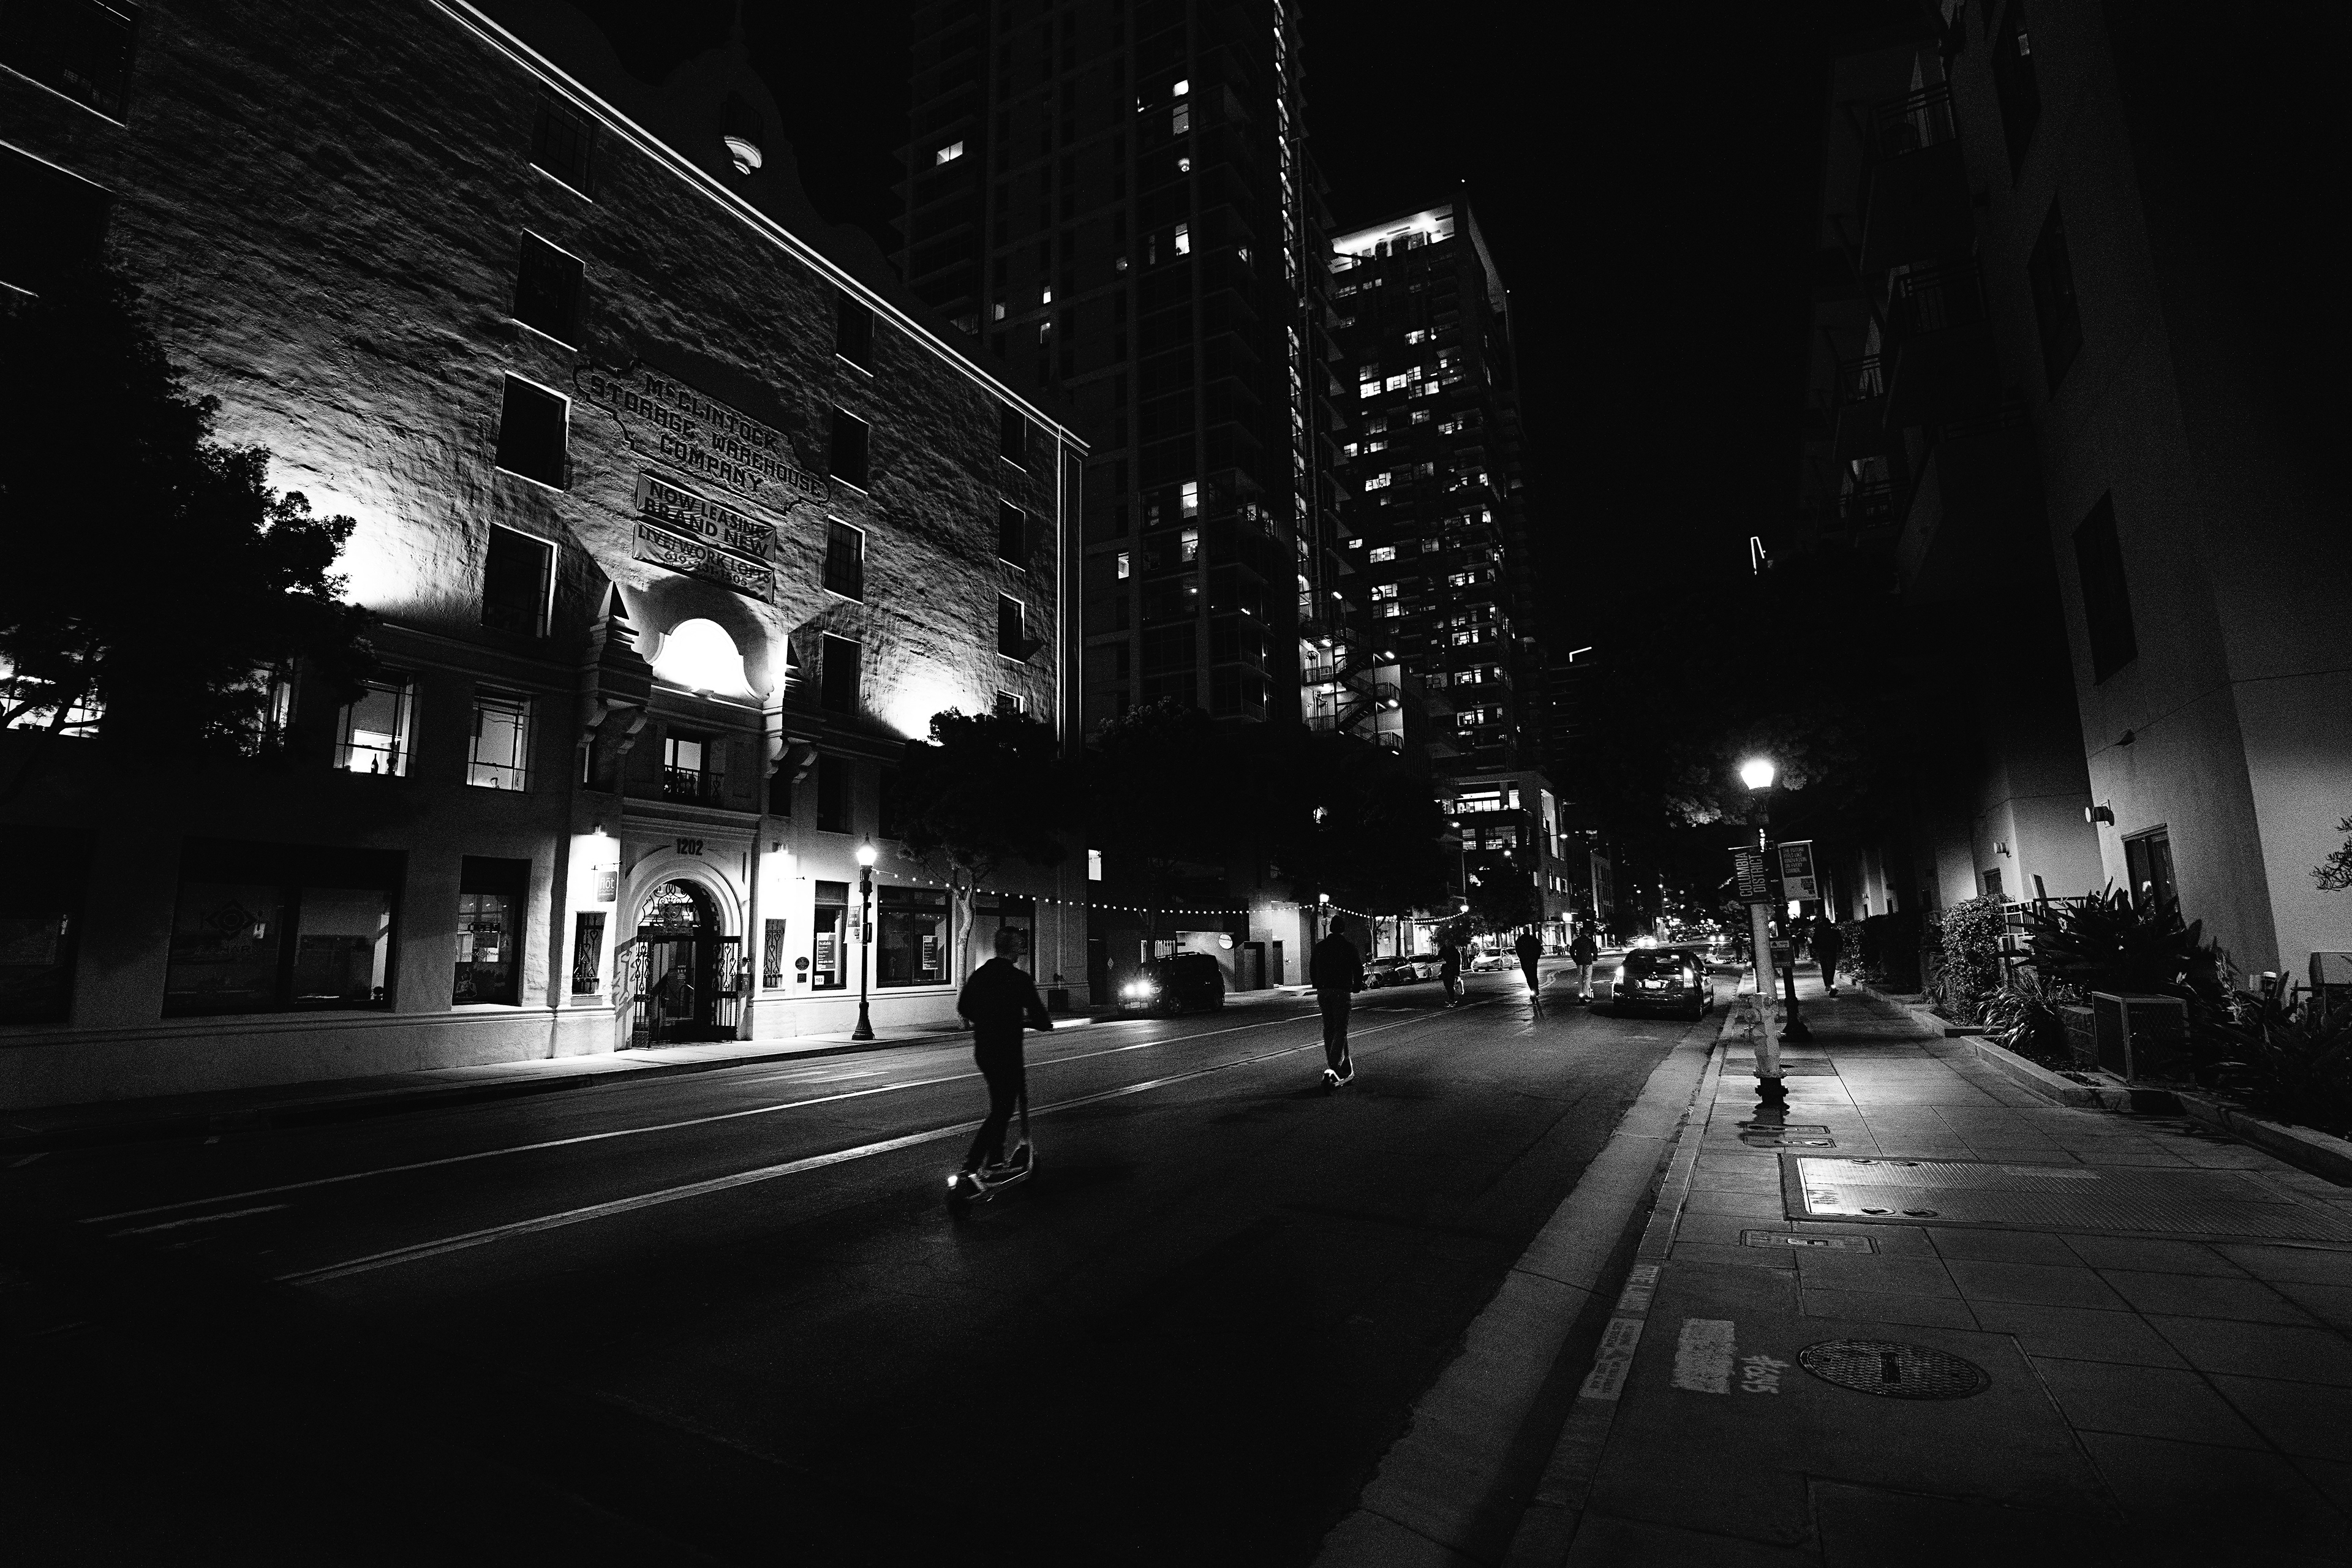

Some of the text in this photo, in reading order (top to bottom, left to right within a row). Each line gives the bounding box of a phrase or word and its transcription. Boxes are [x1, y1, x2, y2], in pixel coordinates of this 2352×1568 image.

[590, 375, 822, 498] STORAGE WAREHOUSE
[660, 434, 763, 492] COMPANY
[650, 481, 696, 512] NOW
[644, 497, 768, 556] BRAND NEW
[676, 839, 704, 856] 1202
[1735, 852, 1752, 897] COLUMBIA
[1749, 854, 1766, 892] DISTRICT
